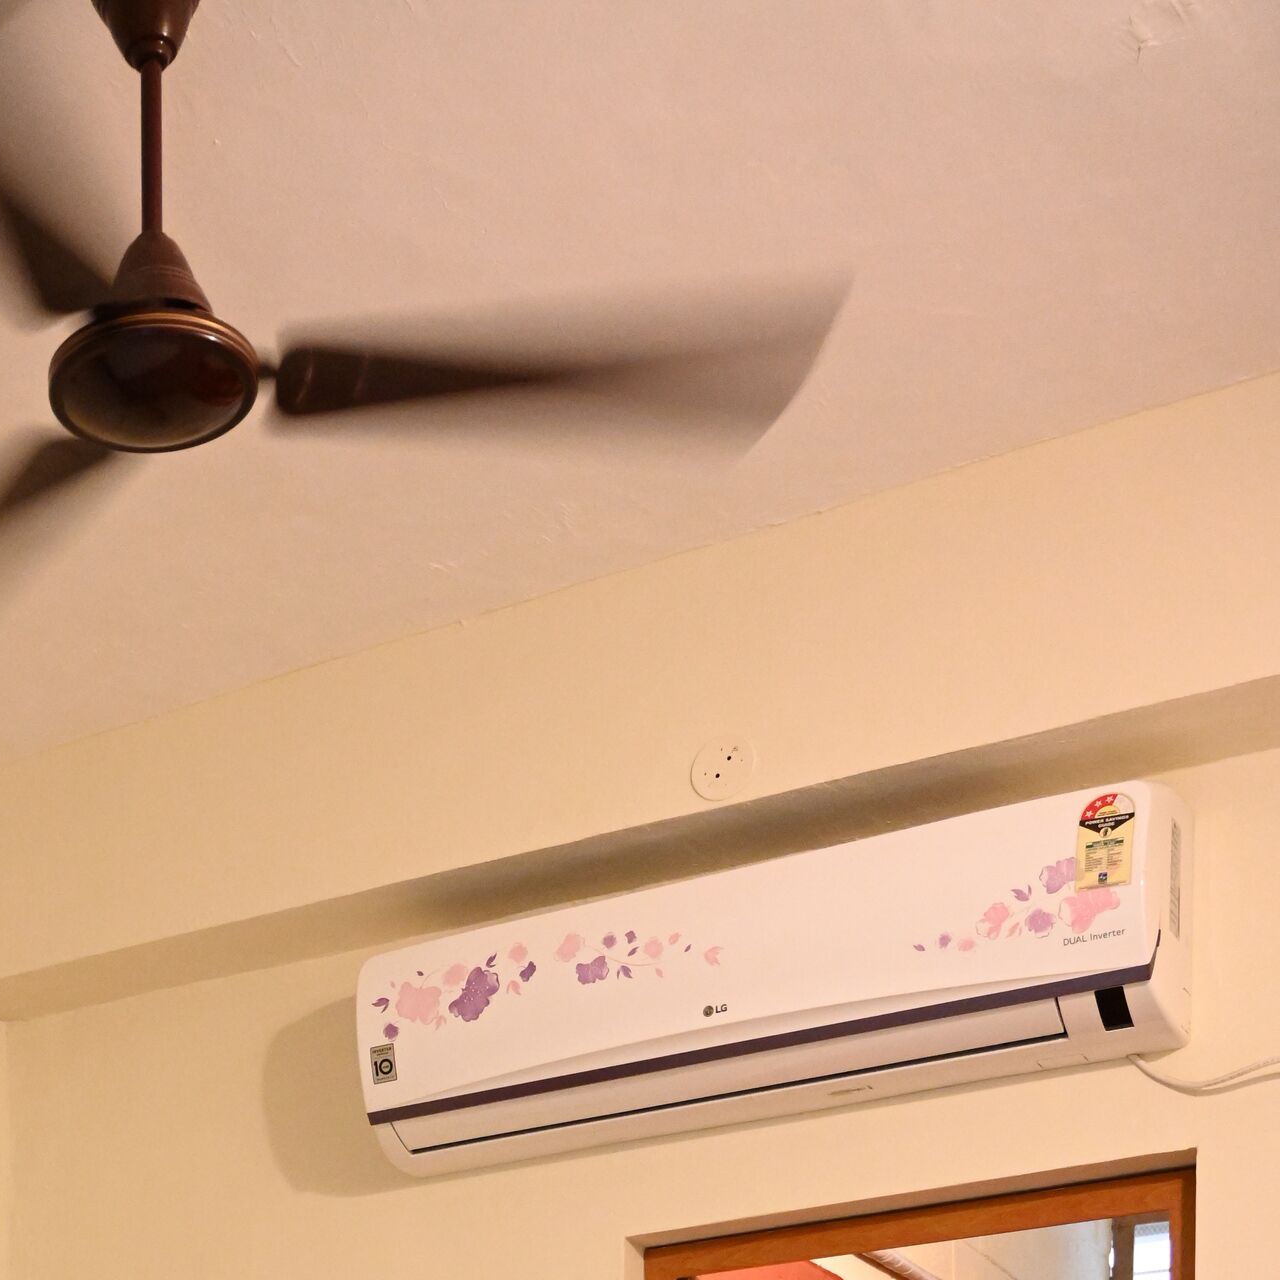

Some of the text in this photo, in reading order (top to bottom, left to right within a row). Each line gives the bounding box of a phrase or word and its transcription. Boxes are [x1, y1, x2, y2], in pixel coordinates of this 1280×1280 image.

[1063, 929, 1126, 946] DUAL Inverter
[715, 1004, 728, 1014] LG
[373, 1058, 393, 1077] 10
